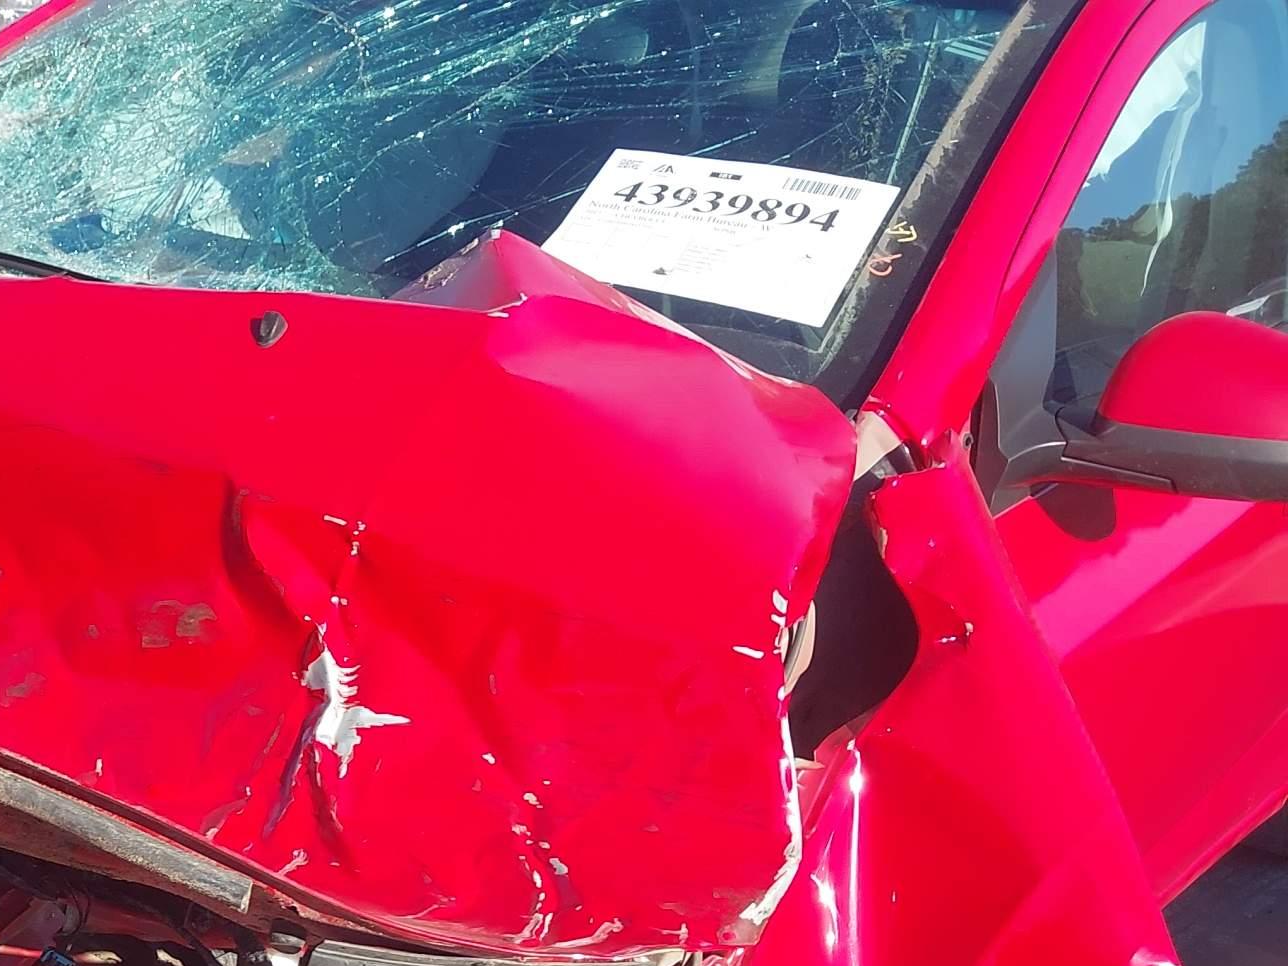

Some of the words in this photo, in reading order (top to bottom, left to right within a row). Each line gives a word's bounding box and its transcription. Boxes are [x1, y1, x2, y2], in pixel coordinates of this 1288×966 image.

[588, 199, 621, 211] North
[623, 204, 672, 217] Carolina
[673, 210, 704, 222] Farm
[707, 215, 749, 229] Bureau
[613, 180, 841, 233] 43939894
